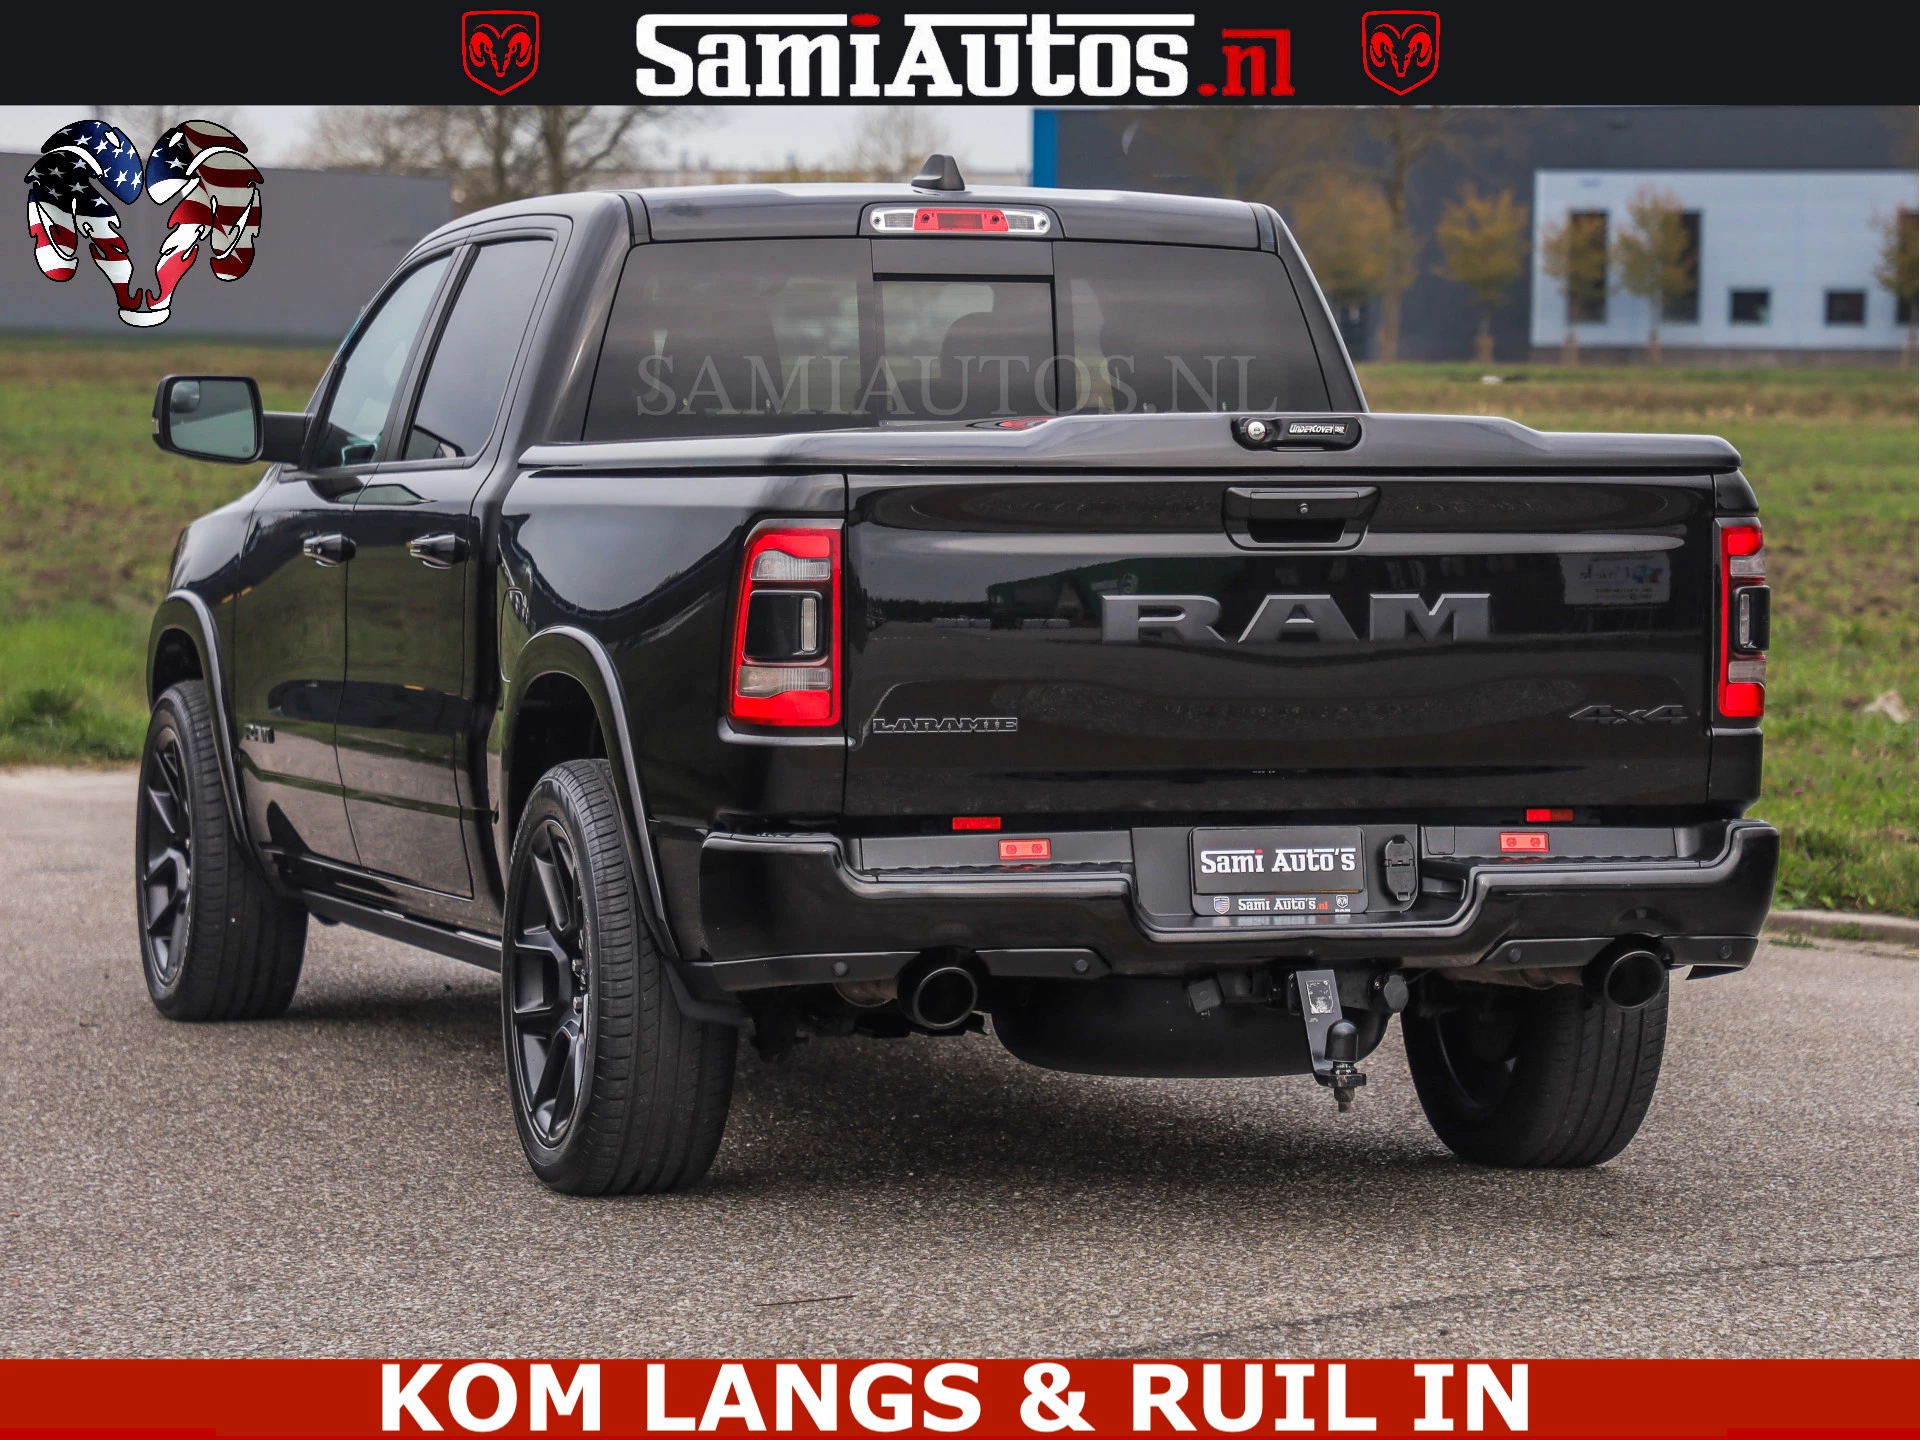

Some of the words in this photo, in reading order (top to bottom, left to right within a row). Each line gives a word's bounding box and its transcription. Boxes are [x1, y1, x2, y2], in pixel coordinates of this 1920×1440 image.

[1101, 592, 1492, 644] RAM
[872, 717, 1018, 734] LARAMIE
[1200, 849, 1265, 874] Sami
[1271, 848, 1357, 873] Auto's
[1237, 898, 1271, 912] Sami
